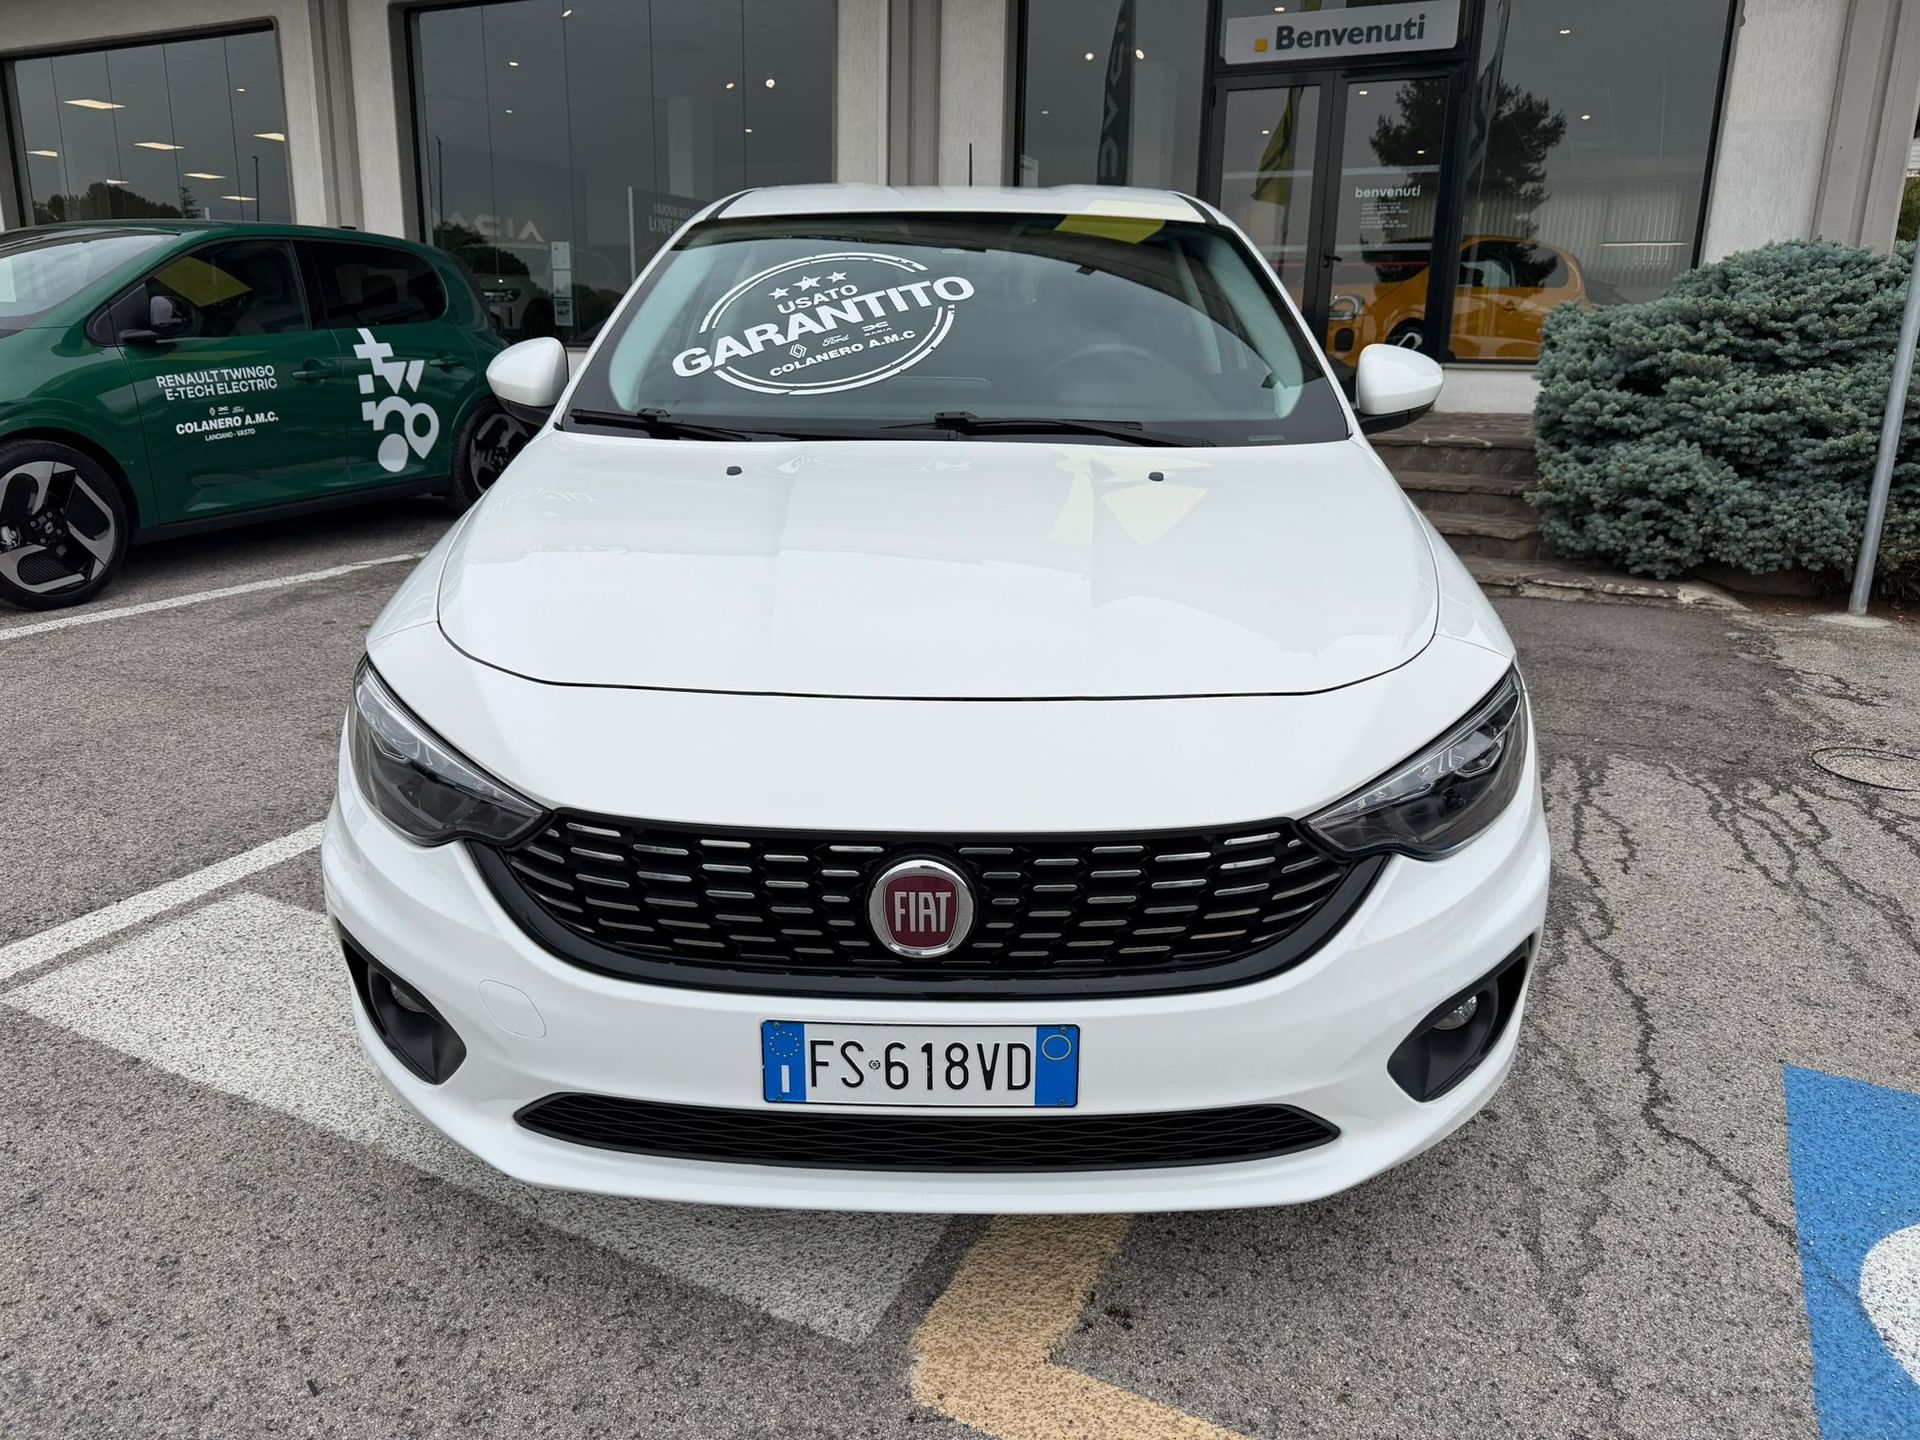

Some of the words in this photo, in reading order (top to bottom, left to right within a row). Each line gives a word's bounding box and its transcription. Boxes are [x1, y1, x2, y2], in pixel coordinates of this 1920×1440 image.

[1276, 13, 1426, 51] Benvenuti
[1355, 185, 1421, 198] benvenuti
[777, 284, 858, 315] USATO
[672, 276, 975, 378] GARANTITO
[769, 343, 865, 377] COLANERO
[869, 330, 917, 350] A.M.C
[156, 370, 218, 388] RENAULT
[221, 365, 275, 381] TWINGO
[165, 385, 214, 400] E-TECH
[216, 378, 277, 395] ELECTRIC
[175, 416, 242, 435] COLANERO
[244, 411, 279, 425] A.M.C.
[204, 431, 234, 442] LANCIANO
[237, 428, 256, 437] VASTO
[894, 891, 951, 933] FIAT
